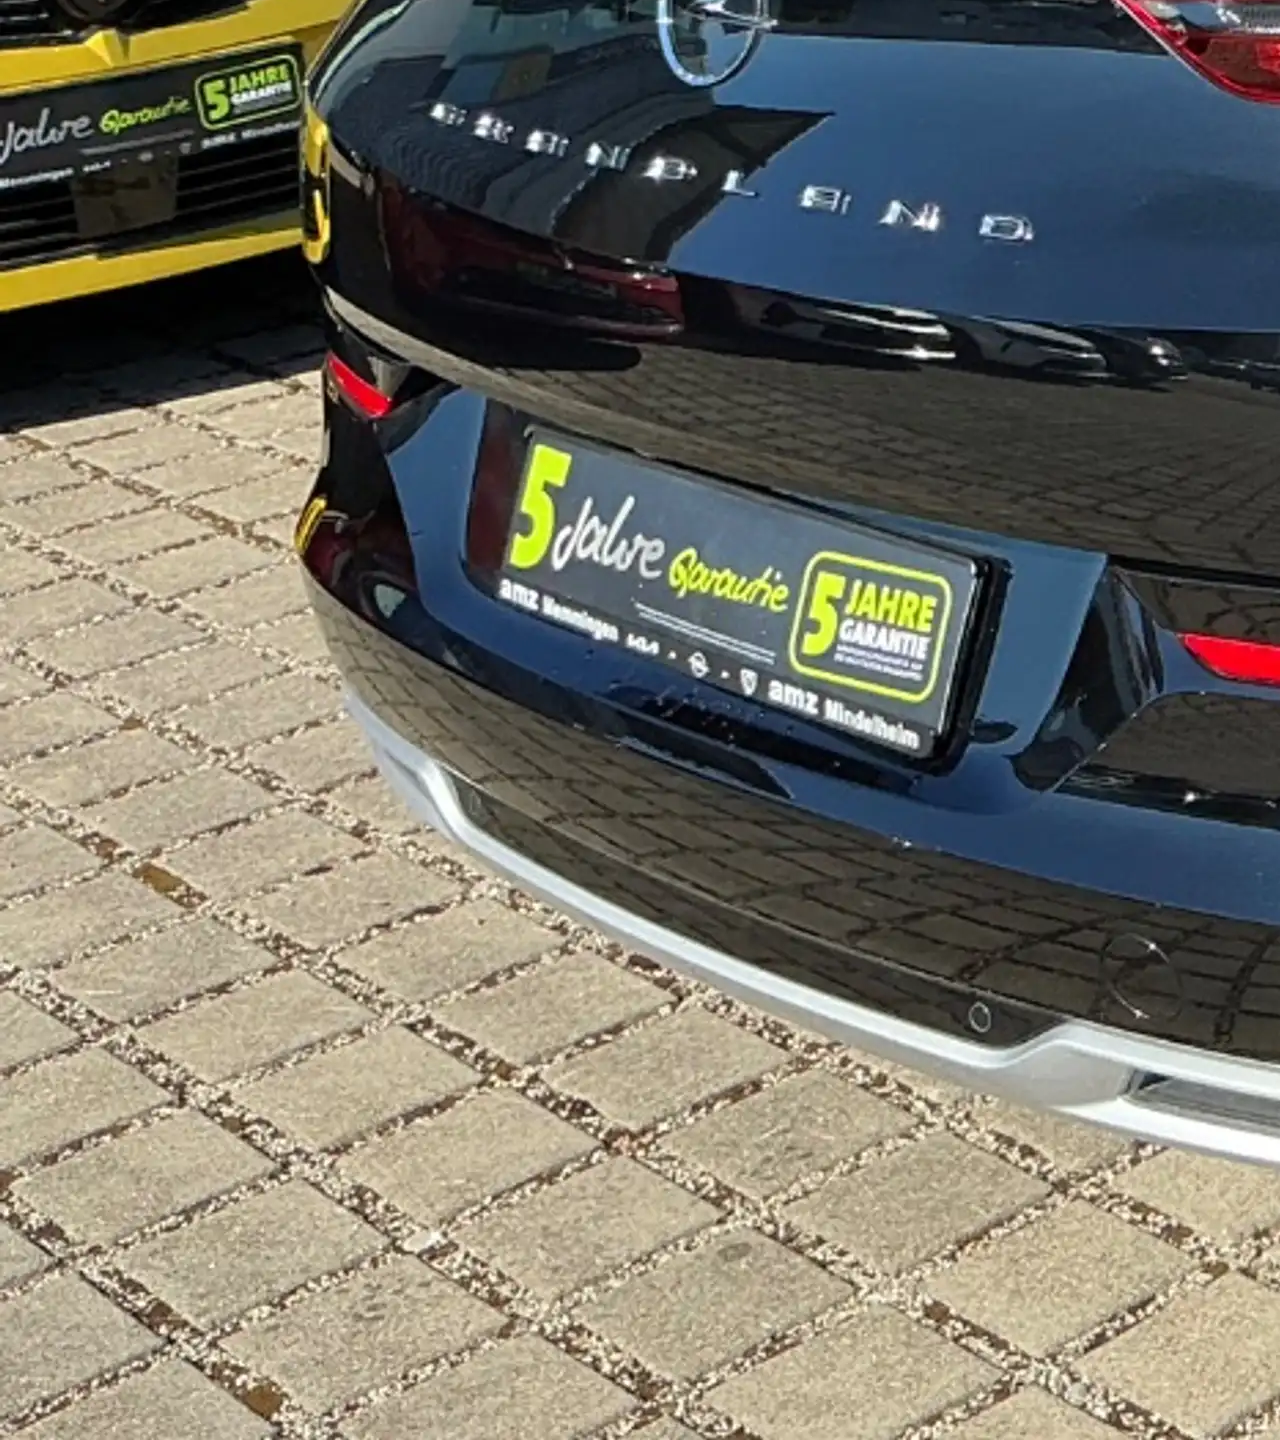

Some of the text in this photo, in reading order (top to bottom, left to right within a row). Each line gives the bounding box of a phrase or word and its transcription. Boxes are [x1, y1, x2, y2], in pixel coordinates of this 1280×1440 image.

[203, 78, 231, 121] 5
[230, 63, 289, 94] JAHRE
[508, 443, 572, 569] 5
[801, 571, 847, 656] 5
[844, 579, 938, 633] JAHRE
[499, 577, 540, 612] amz
[766, 678, 820, 716] amz
[837, 619, 932, 660] GARANTIE
